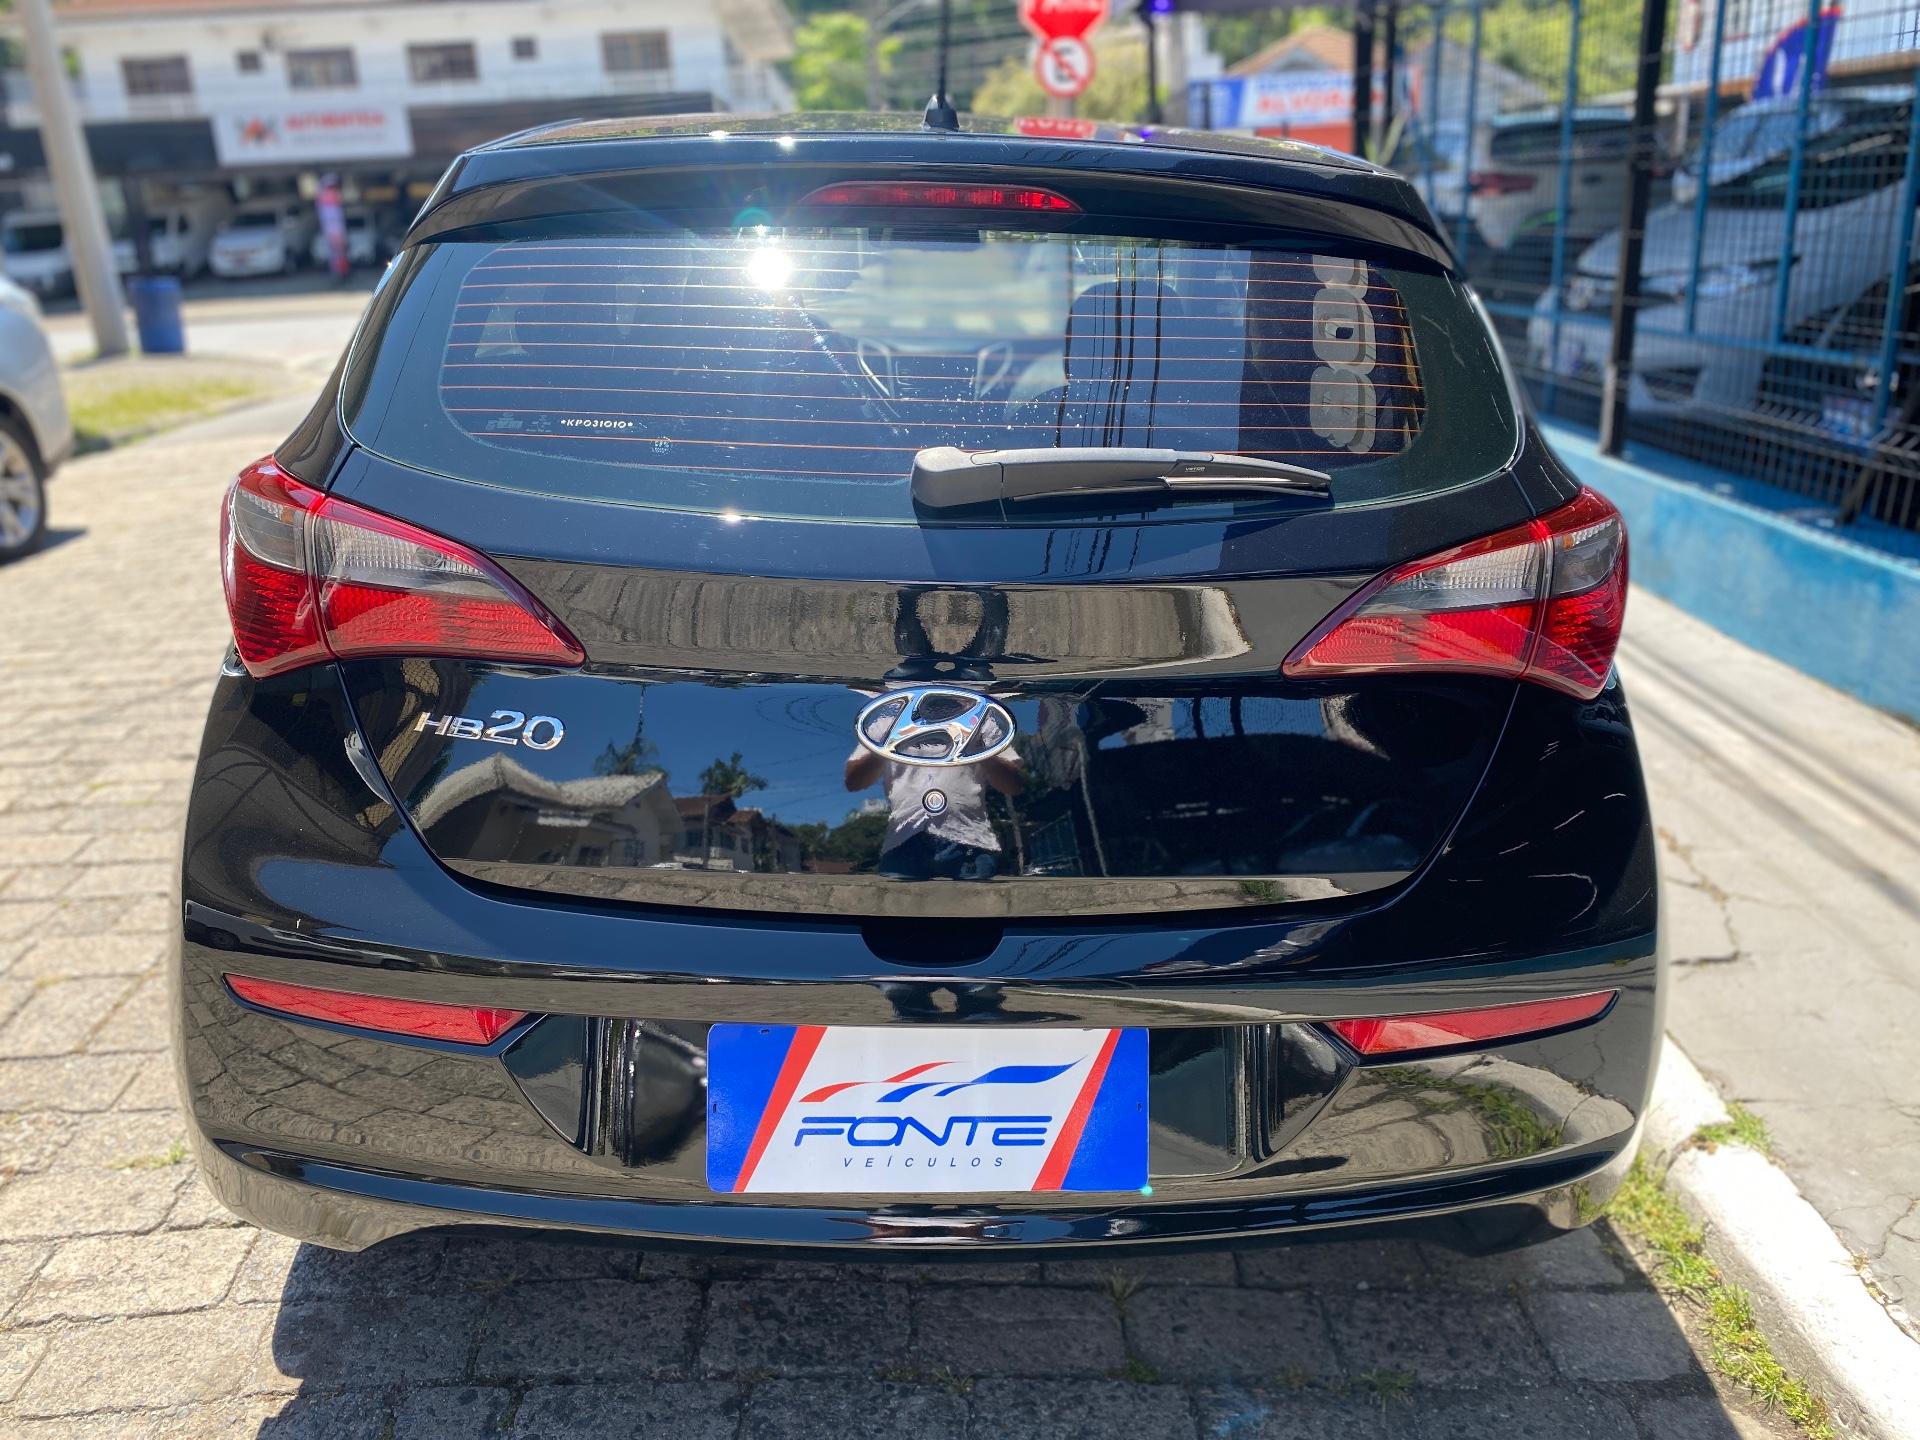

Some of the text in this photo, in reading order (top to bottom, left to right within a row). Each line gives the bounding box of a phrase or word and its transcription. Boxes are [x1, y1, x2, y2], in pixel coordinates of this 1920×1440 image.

[414, 709, 566, 751] HB20
[793, 1115, 1053, 1147] FONTE
[843, 1156, 1005, 1168] VEÍCULOS
